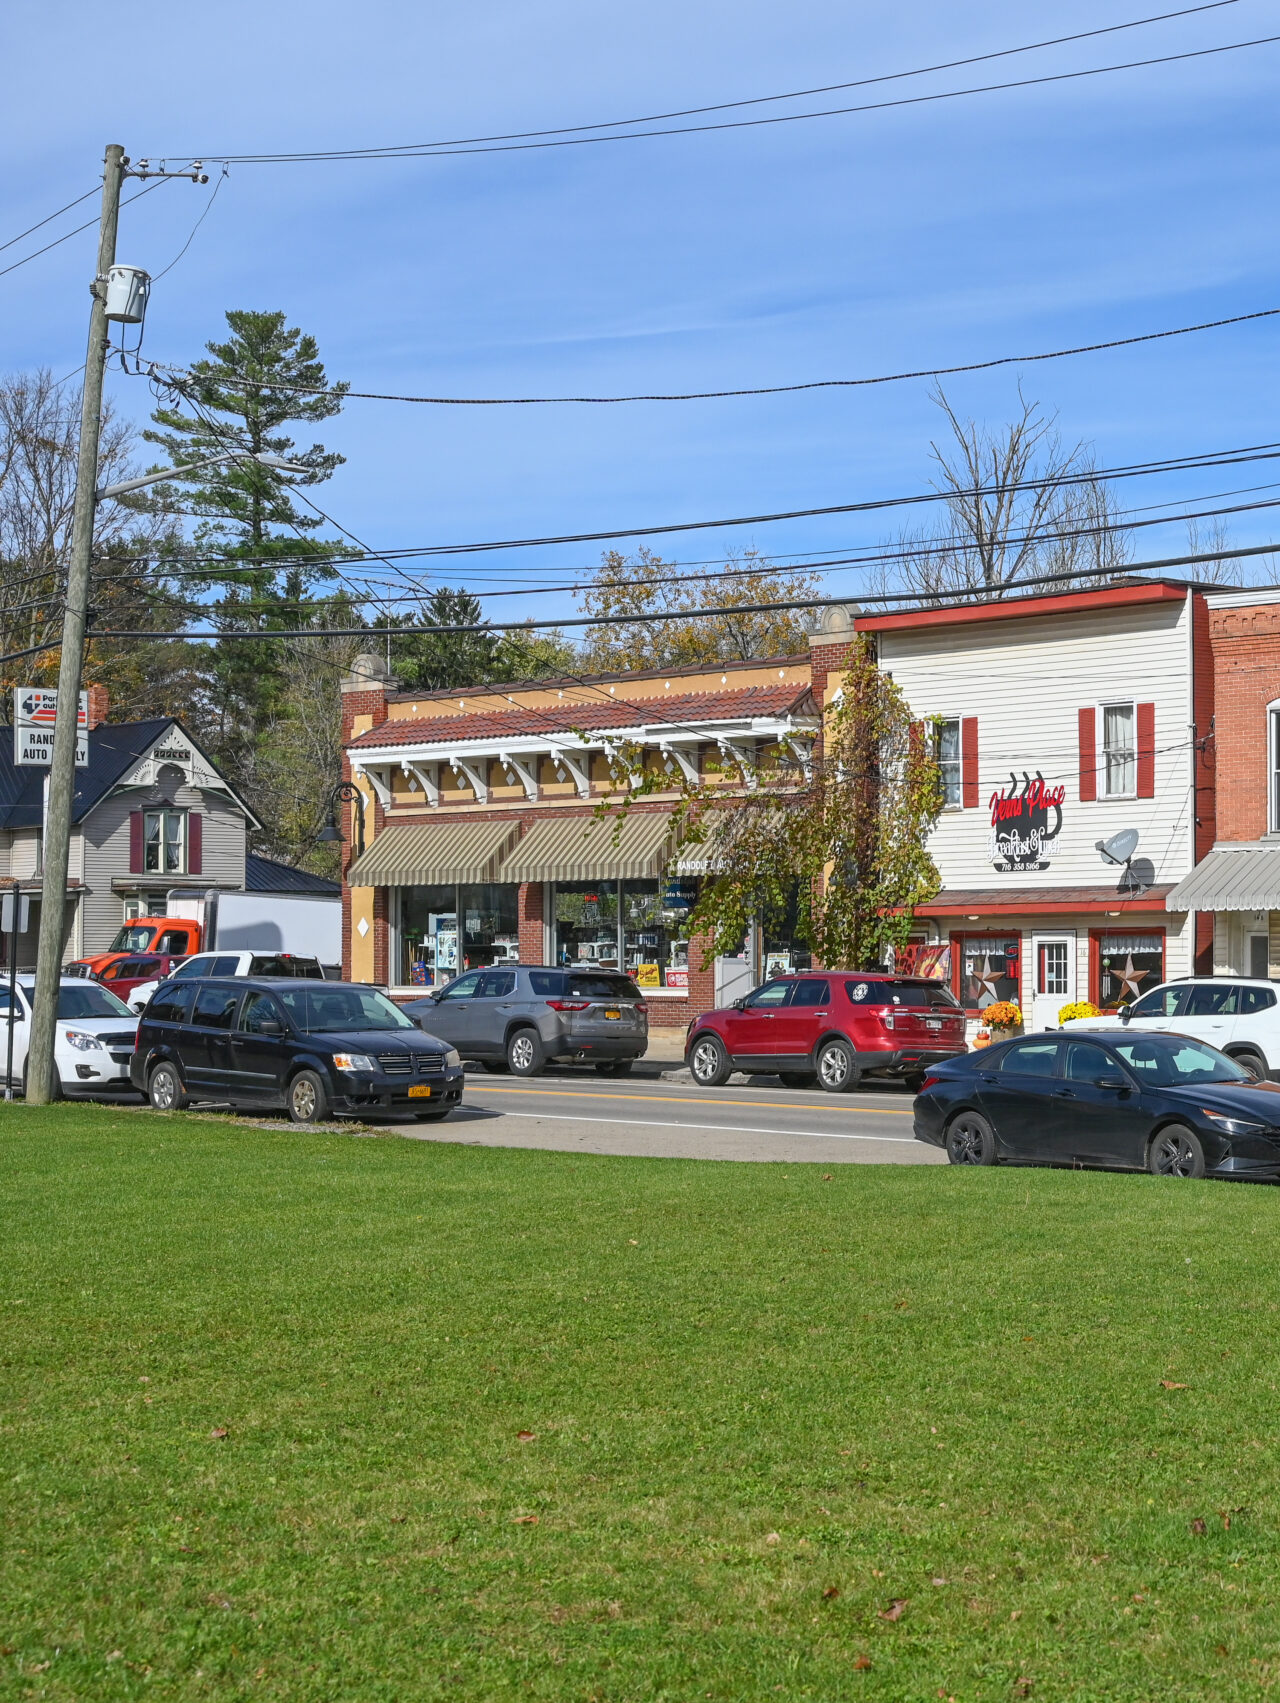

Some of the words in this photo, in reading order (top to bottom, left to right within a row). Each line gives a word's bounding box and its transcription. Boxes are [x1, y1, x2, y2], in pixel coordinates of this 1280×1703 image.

[29, 734, 54, 745] RAND
[23, 748, 48, 760] AUTO
[1027, 778, 1065, 818] Place
[1030, 828, 1038, 851] &
